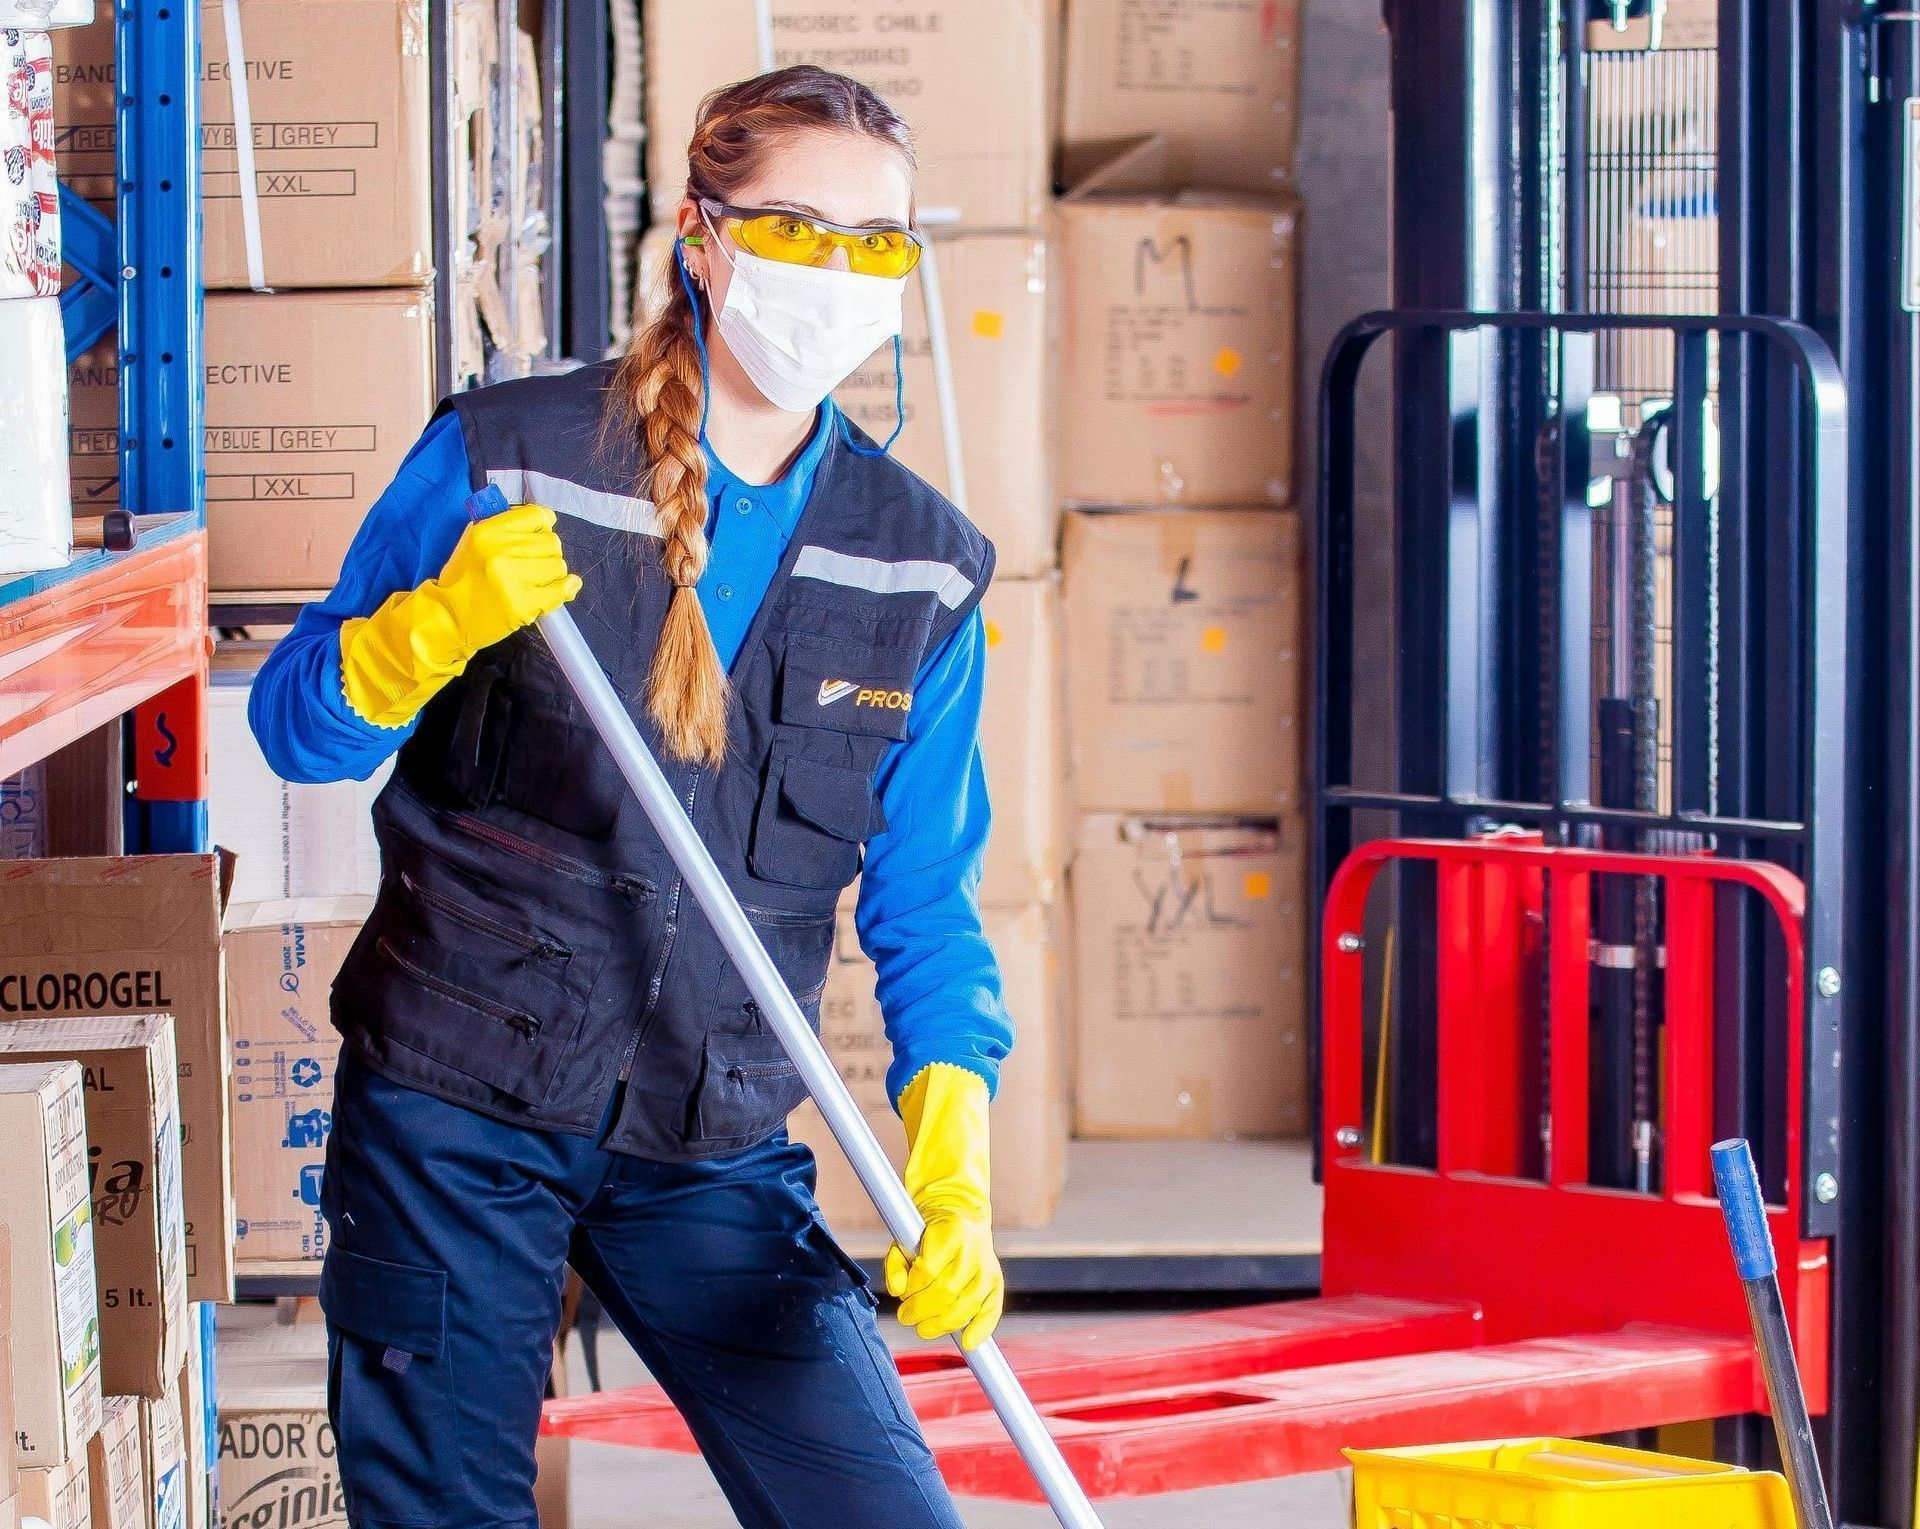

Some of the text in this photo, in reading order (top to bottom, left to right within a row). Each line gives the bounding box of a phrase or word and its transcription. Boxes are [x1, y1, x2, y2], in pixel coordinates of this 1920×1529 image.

[281, 126, 339, 145] GREY
[266, 175, 311, 193] XXL
[1134, 234, 1197, 312] M
[206, 364, 292, 384] ECTIVE
[280, 431, 337, 449] GREY
[264, 479, 309, 496] XXL
[855, 689, 913, 712] PROS
[0, 970, 172, 1013] CLOROGEL
[84, 1067, 115, 1092] AL
[105, 1287, 153, 1308] 5 lt.
